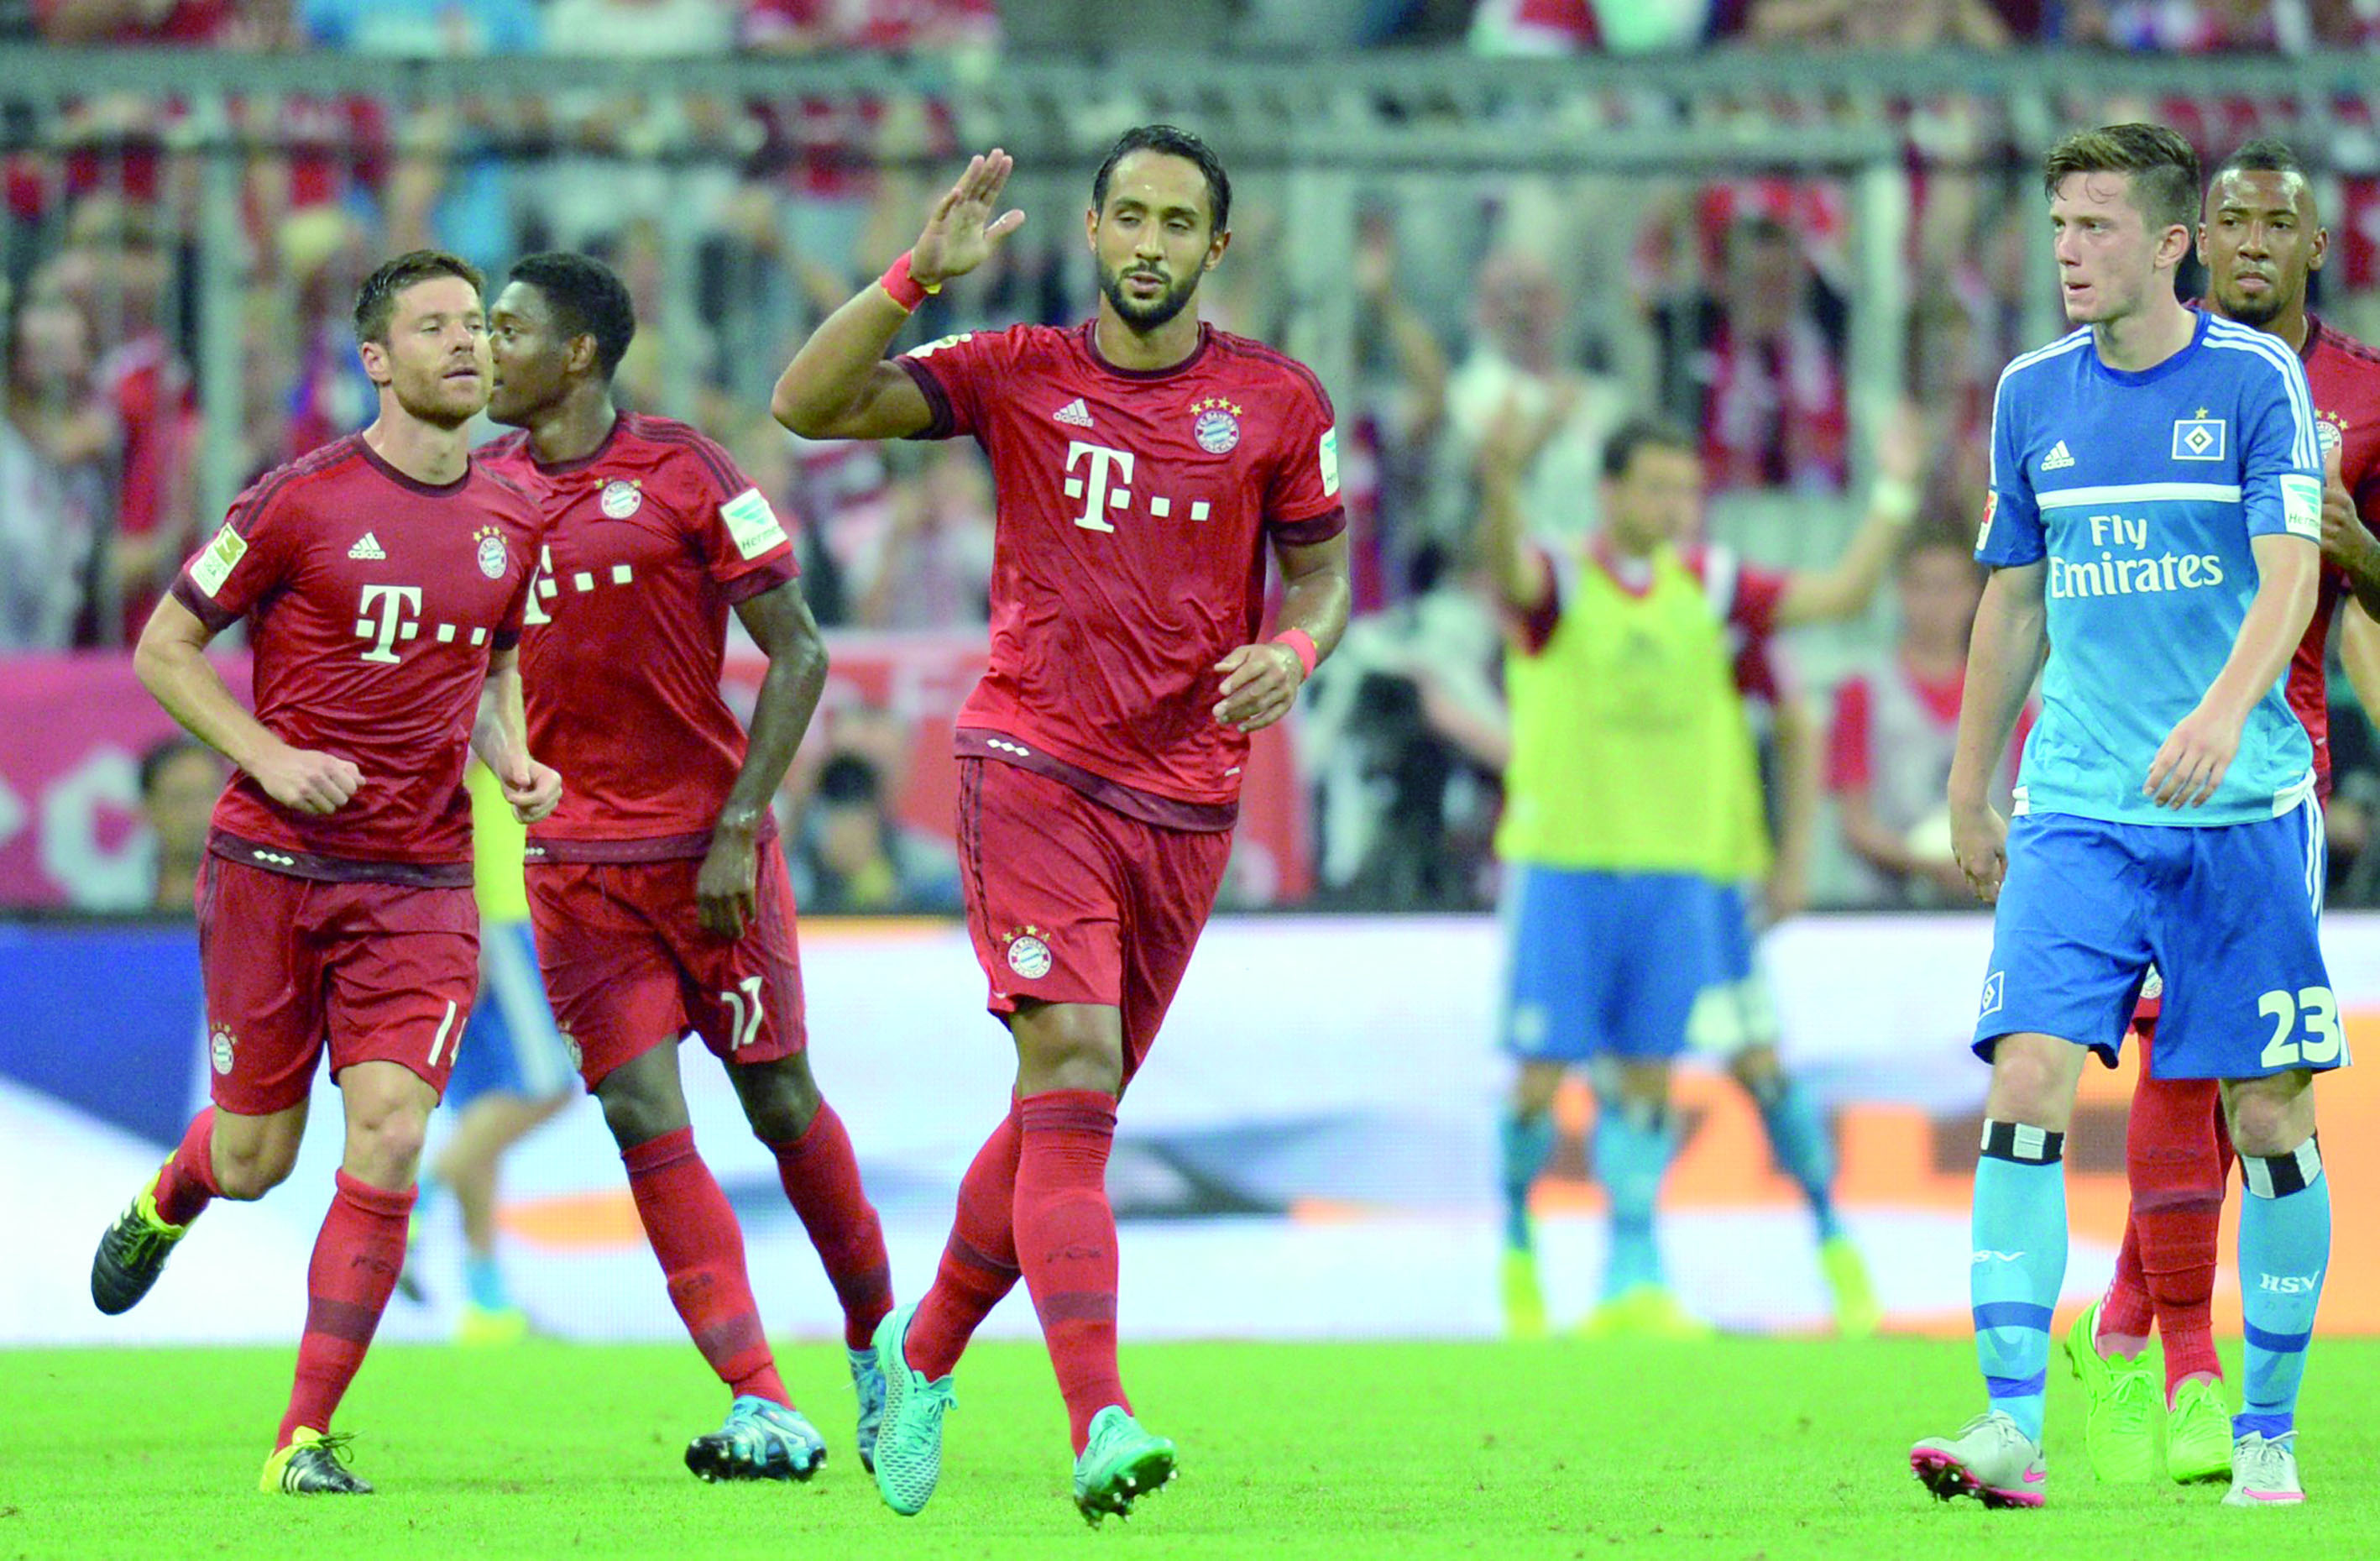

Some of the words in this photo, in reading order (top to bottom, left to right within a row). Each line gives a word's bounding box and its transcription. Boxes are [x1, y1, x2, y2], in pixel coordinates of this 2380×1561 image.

[1064, 441, 1134, 533] T
[2089, 514, 2147, 551] Fly
[2048, 551, 2224, 599] Emirates
[356, 584, 422, 663] T
[2257, 985, 2341, 1068] 23
[2259, 1270, 2320, 1293] HSV
